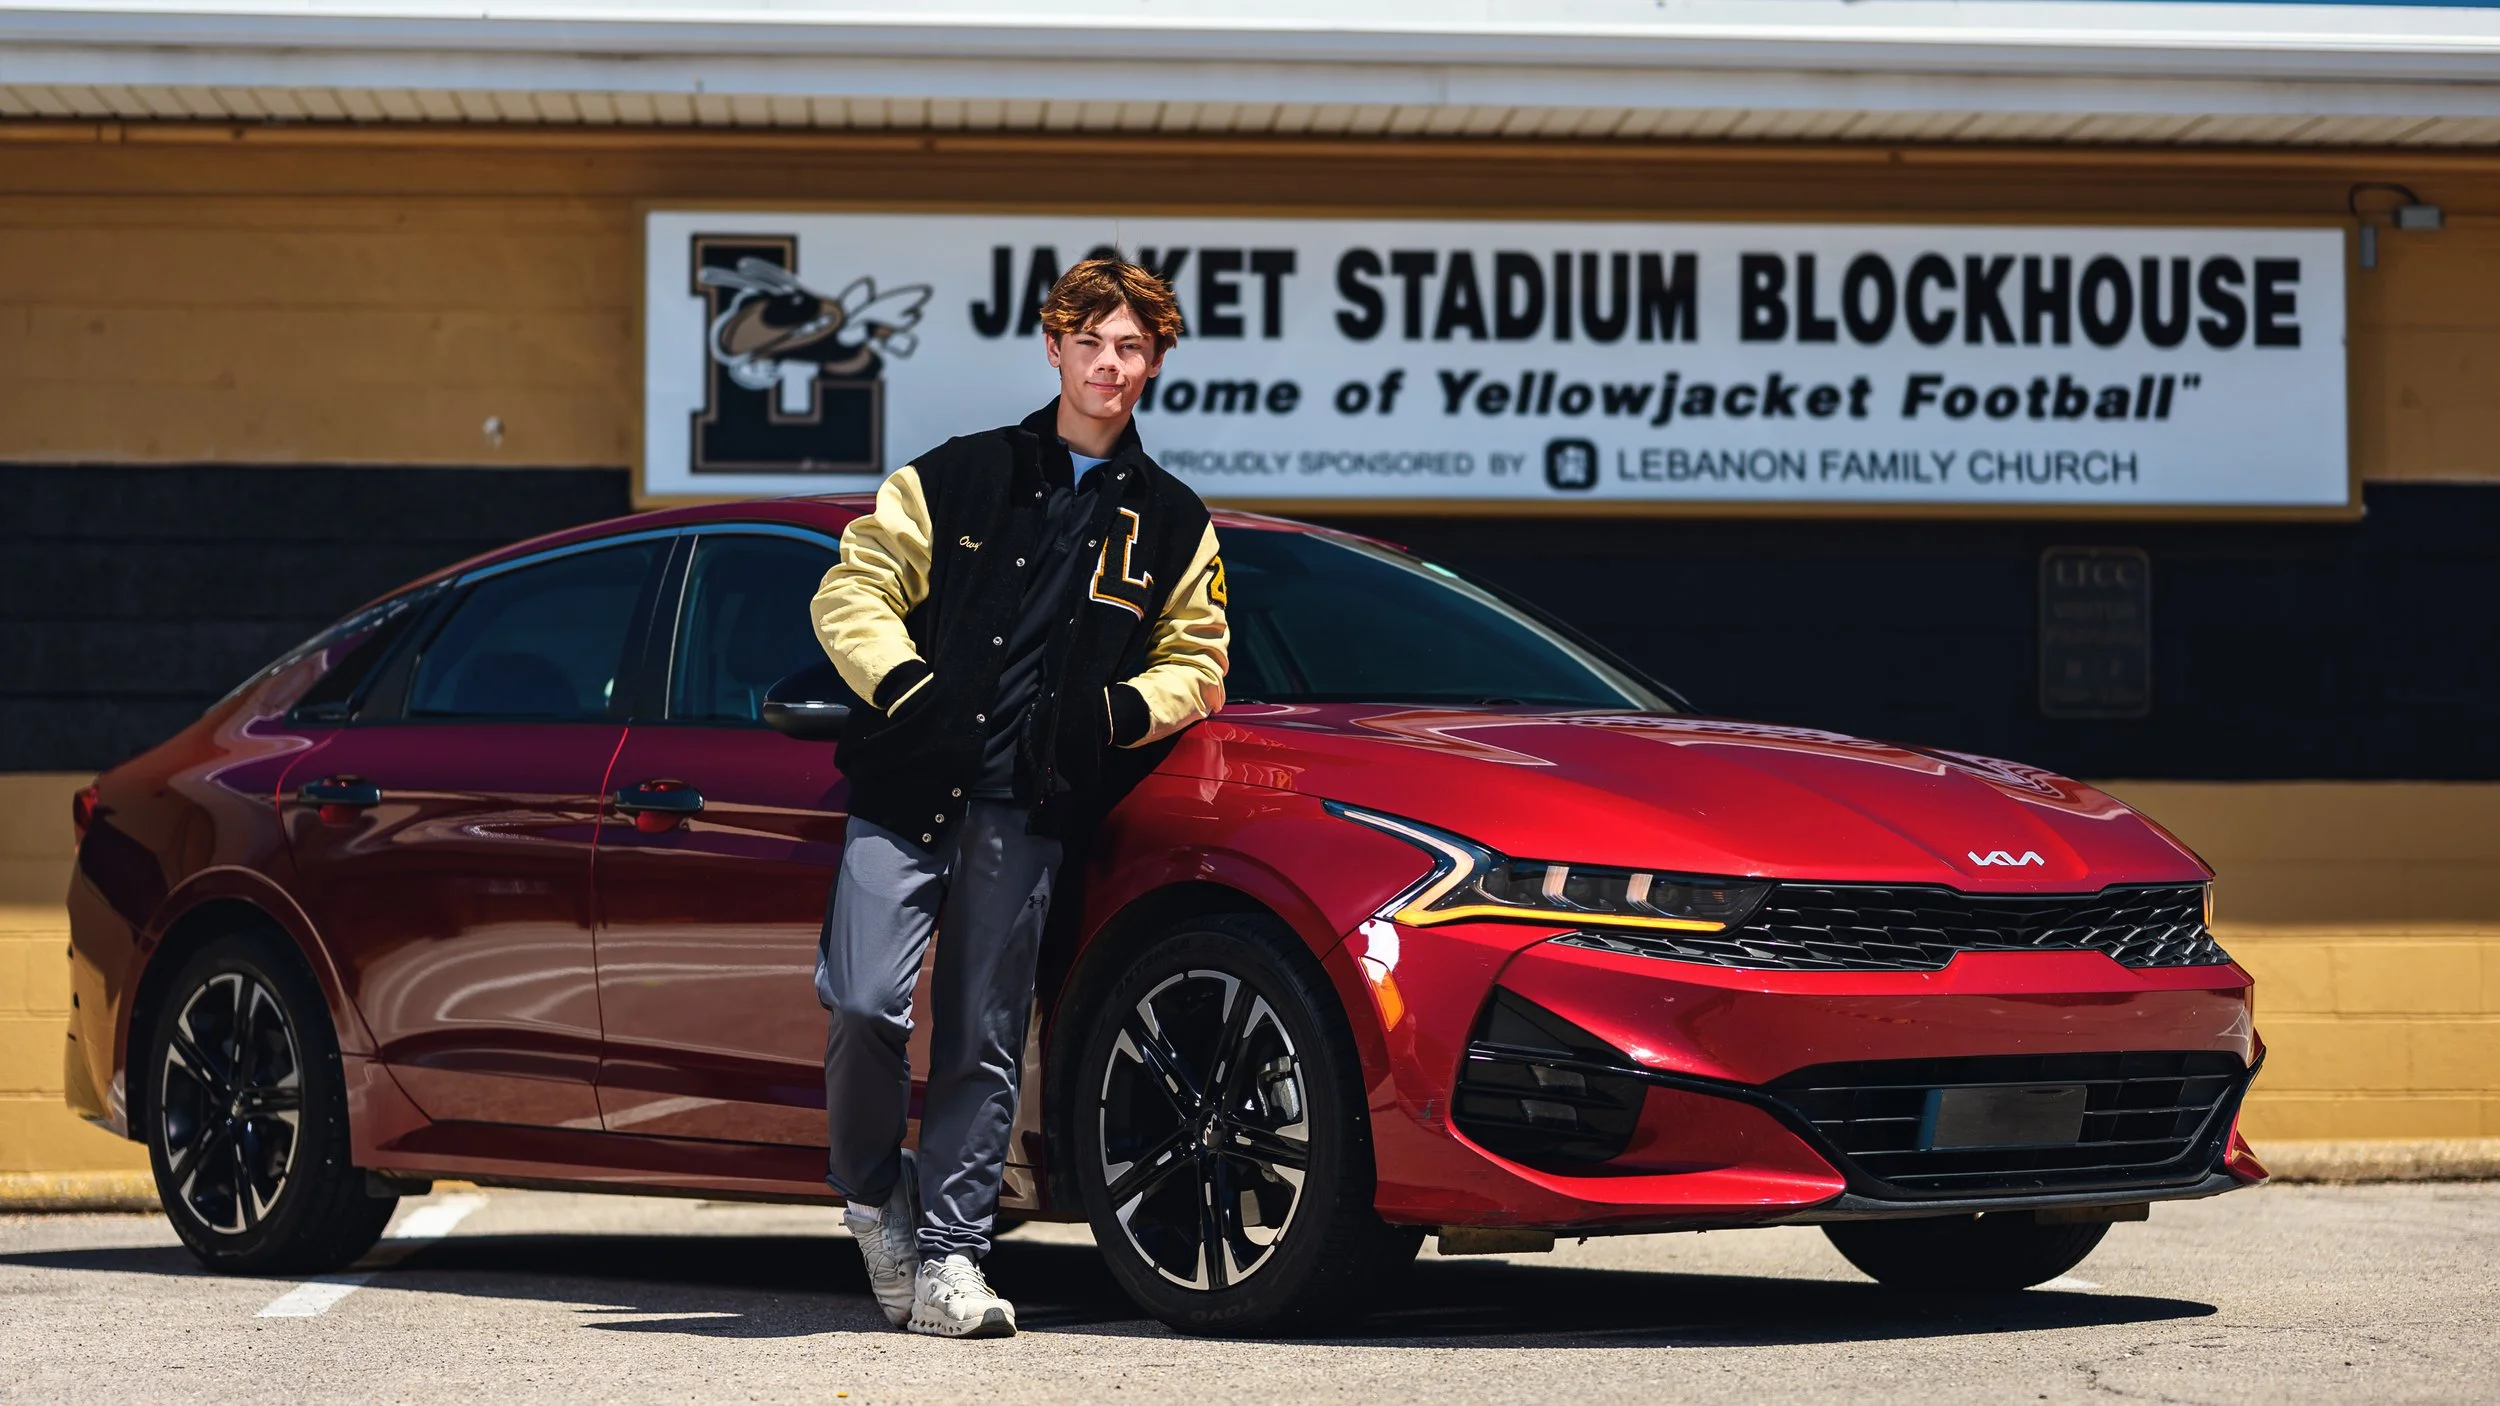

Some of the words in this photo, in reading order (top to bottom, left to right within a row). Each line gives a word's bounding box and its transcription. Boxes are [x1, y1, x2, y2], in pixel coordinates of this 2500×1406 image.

[969, 245, 1297, 340] JAKET
[1335, 247, 1699, 345] STADIUM
[1739, 251, 2302, 350] BLOCKHOUSE
[1334, 369, 1405, 416] of
[1437, 369, 1873, 428] Yellowjacket
[1901, 373, 2202, 421] Football"
[1160, 450, 1290, 475] PROUDLY
[1299, 451, 1474, 476] SPONSORED
[1489, 453, 1525, 475] BY
[1617, 449, 1807, 482] LEBANON
[1819, 450, 1956, 483] FAMILY
[1967, 450, 2138, 485] CHURCH
[1089, 506, 1154, 622] L
[1967, 850, 2045, 866] KIA
[1190, 1296, 1259, 1323] TOYO
